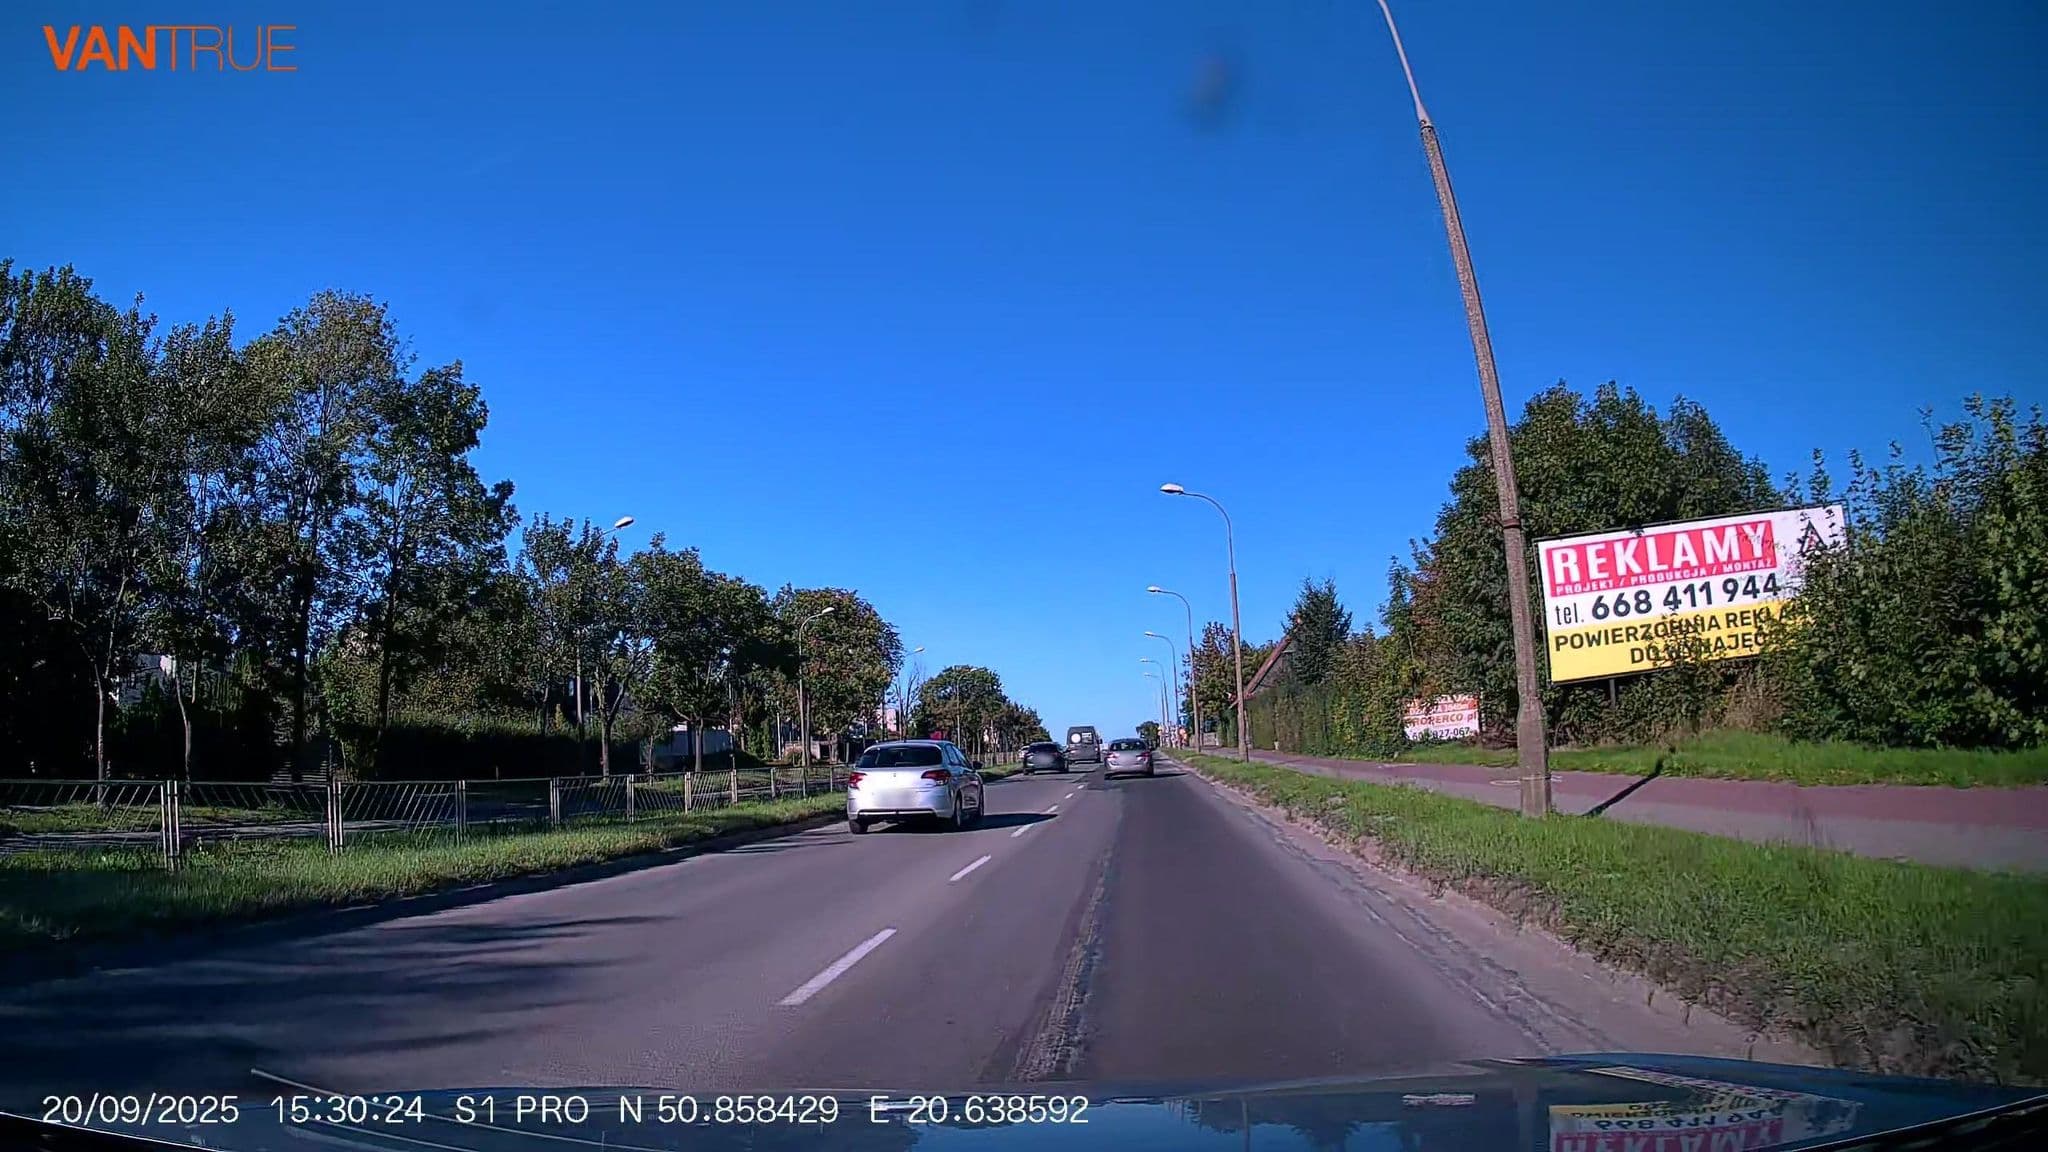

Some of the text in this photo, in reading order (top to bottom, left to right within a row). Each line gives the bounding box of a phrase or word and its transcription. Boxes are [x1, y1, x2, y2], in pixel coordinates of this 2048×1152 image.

[1551, 523, 1767, 585] REKLAMY
[1556, 580, 1614, 596] PROJEKT
[1631, 565, 1707, 586] PRODUKCJA
[1556, 572, 1783, 626] tel. 668 411 944
